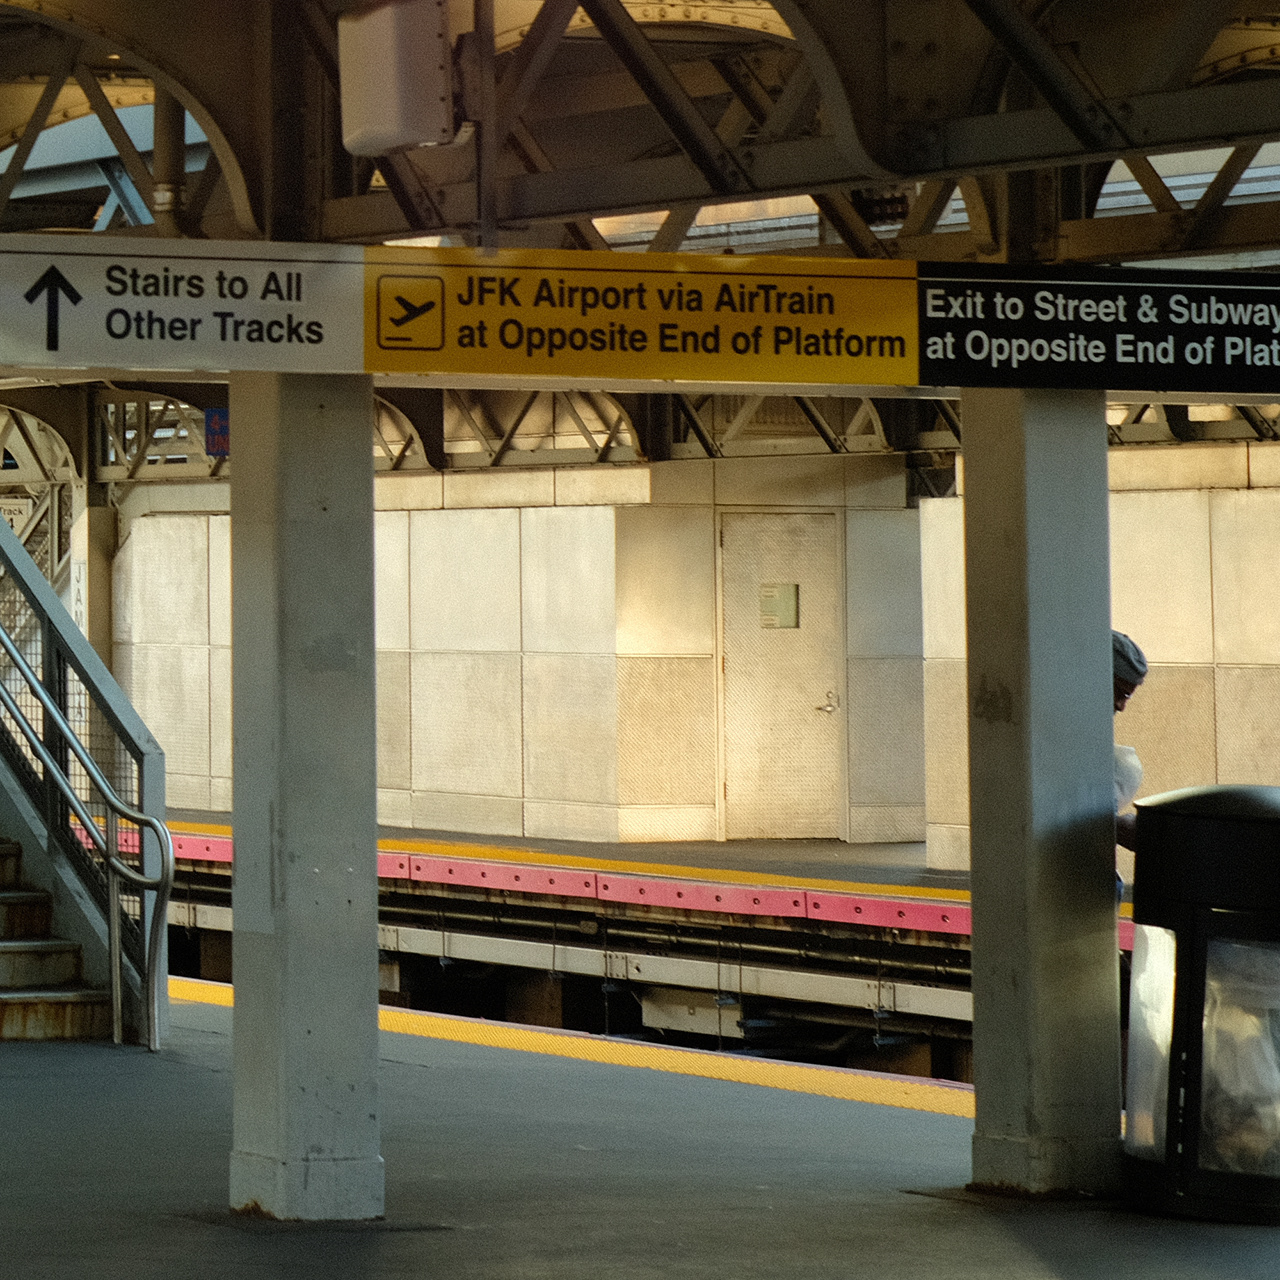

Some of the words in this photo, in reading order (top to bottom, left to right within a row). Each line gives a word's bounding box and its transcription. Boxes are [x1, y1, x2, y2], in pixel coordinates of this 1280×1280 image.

[105, 264, 205, 298] Stairs
[216, 270, 249, 299] to
[260, 271, 302, 302] All
[457, 276, 521, 307] JFK
[532, 278, 647, 316] Airport
[657, 282, 703, 312] via
[714, 283, 835, 315] AirTrain
[925, 288, 985, 319] Exit
[993, 292, 1024, 320] to
[1034, 290, 1128, 323] Street
[1136, 294, 1159, 323] &
[105, 308, 202, 341] Other
[213, 311, 324, 344] Tracks
[457, 321, 488, 349] at
[498, 318, 648, 358] Opposite
[658, 323, 721, 354] End
[731, 325, 762, 355] of
[773, 326, 906, 358] Platform
[926, 331, 956, 360] at
[965, 330, 1107, 369] Opposite
[1115, 334, 1175, 363] End
[1184, 336, 1215, 365] of
